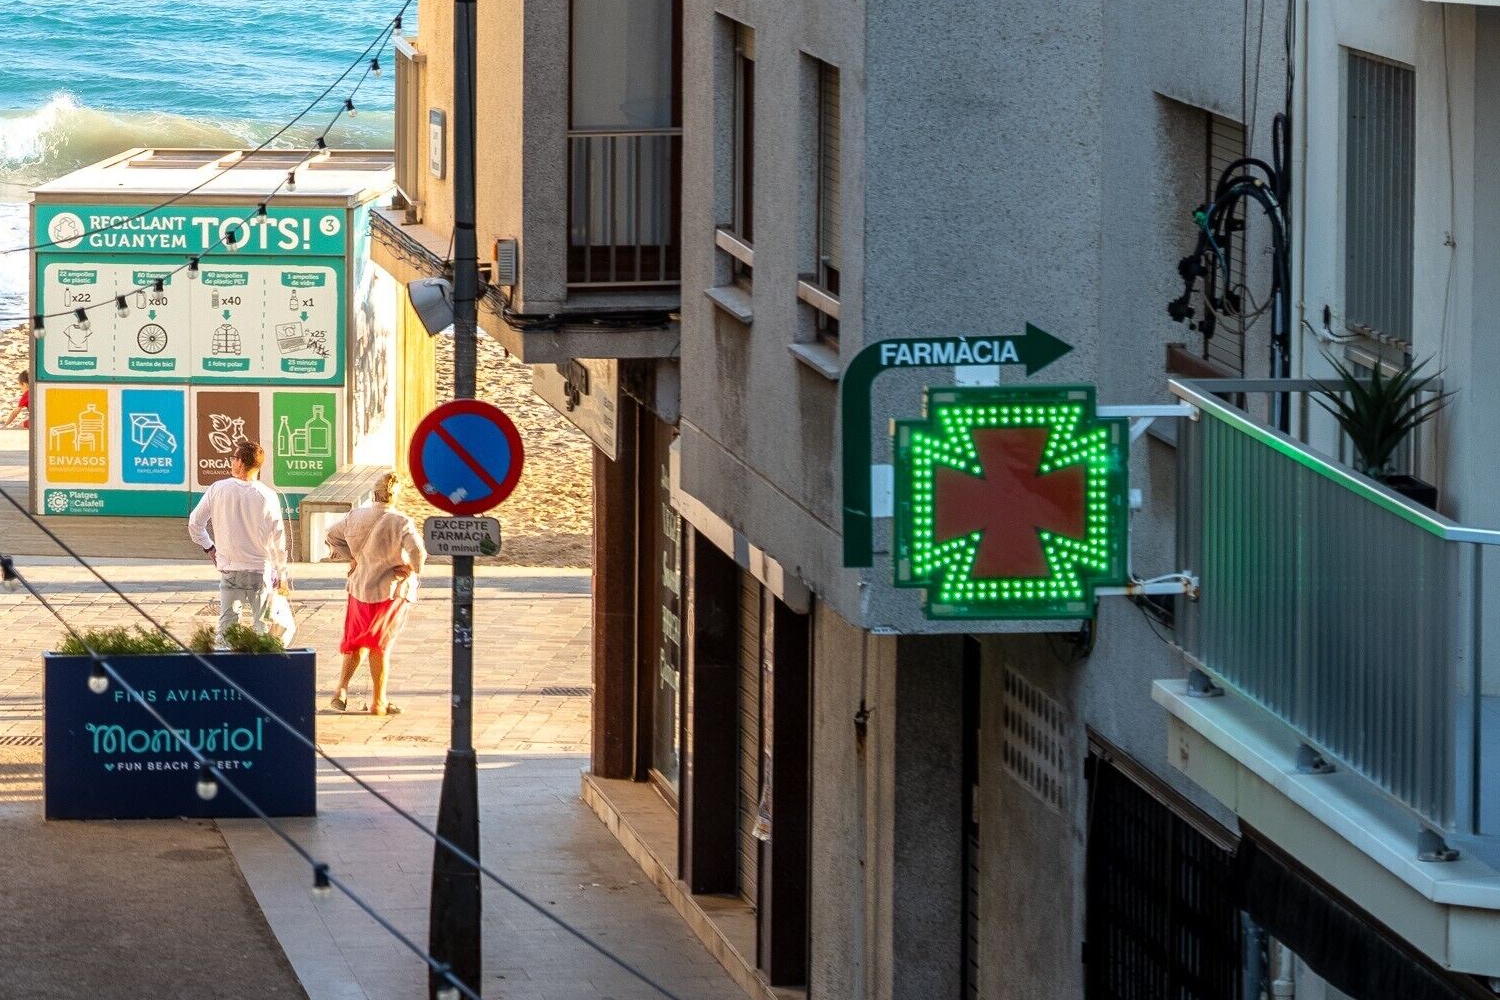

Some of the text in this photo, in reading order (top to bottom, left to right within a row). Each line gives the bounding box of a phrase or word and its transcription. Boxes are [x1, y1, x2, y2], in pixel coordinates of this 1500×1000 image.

[89, 215, 186, 230] RECICLANT
[325, 219, 335, 232] 3
[191, 217, 311, 249] TOTS!
[89, 233, 187, 248] GUANYEM
[72, 294, 91, 303] x22
[221, 297, 241, 306] x40
[302, 298, 315, 307] x1
[880, 336, 1019, 365] FARMÀCIA
[48, 456, 106, 466] ENVASOS
[134, 457, 173, 467] PAPER
[286, 460, 324, 470] VIDRE
[69, 491, 98, 499] Platges
[434, 520, 488, 530] EXCEPTE
[438, 543, 480, 552] 10 minut
[115, 689, 243, 702] FINS AVIAT!!!
[85, 717, 263, 754] Monturiol
[117, 761, 240, 771] FUN BEACH SEET
